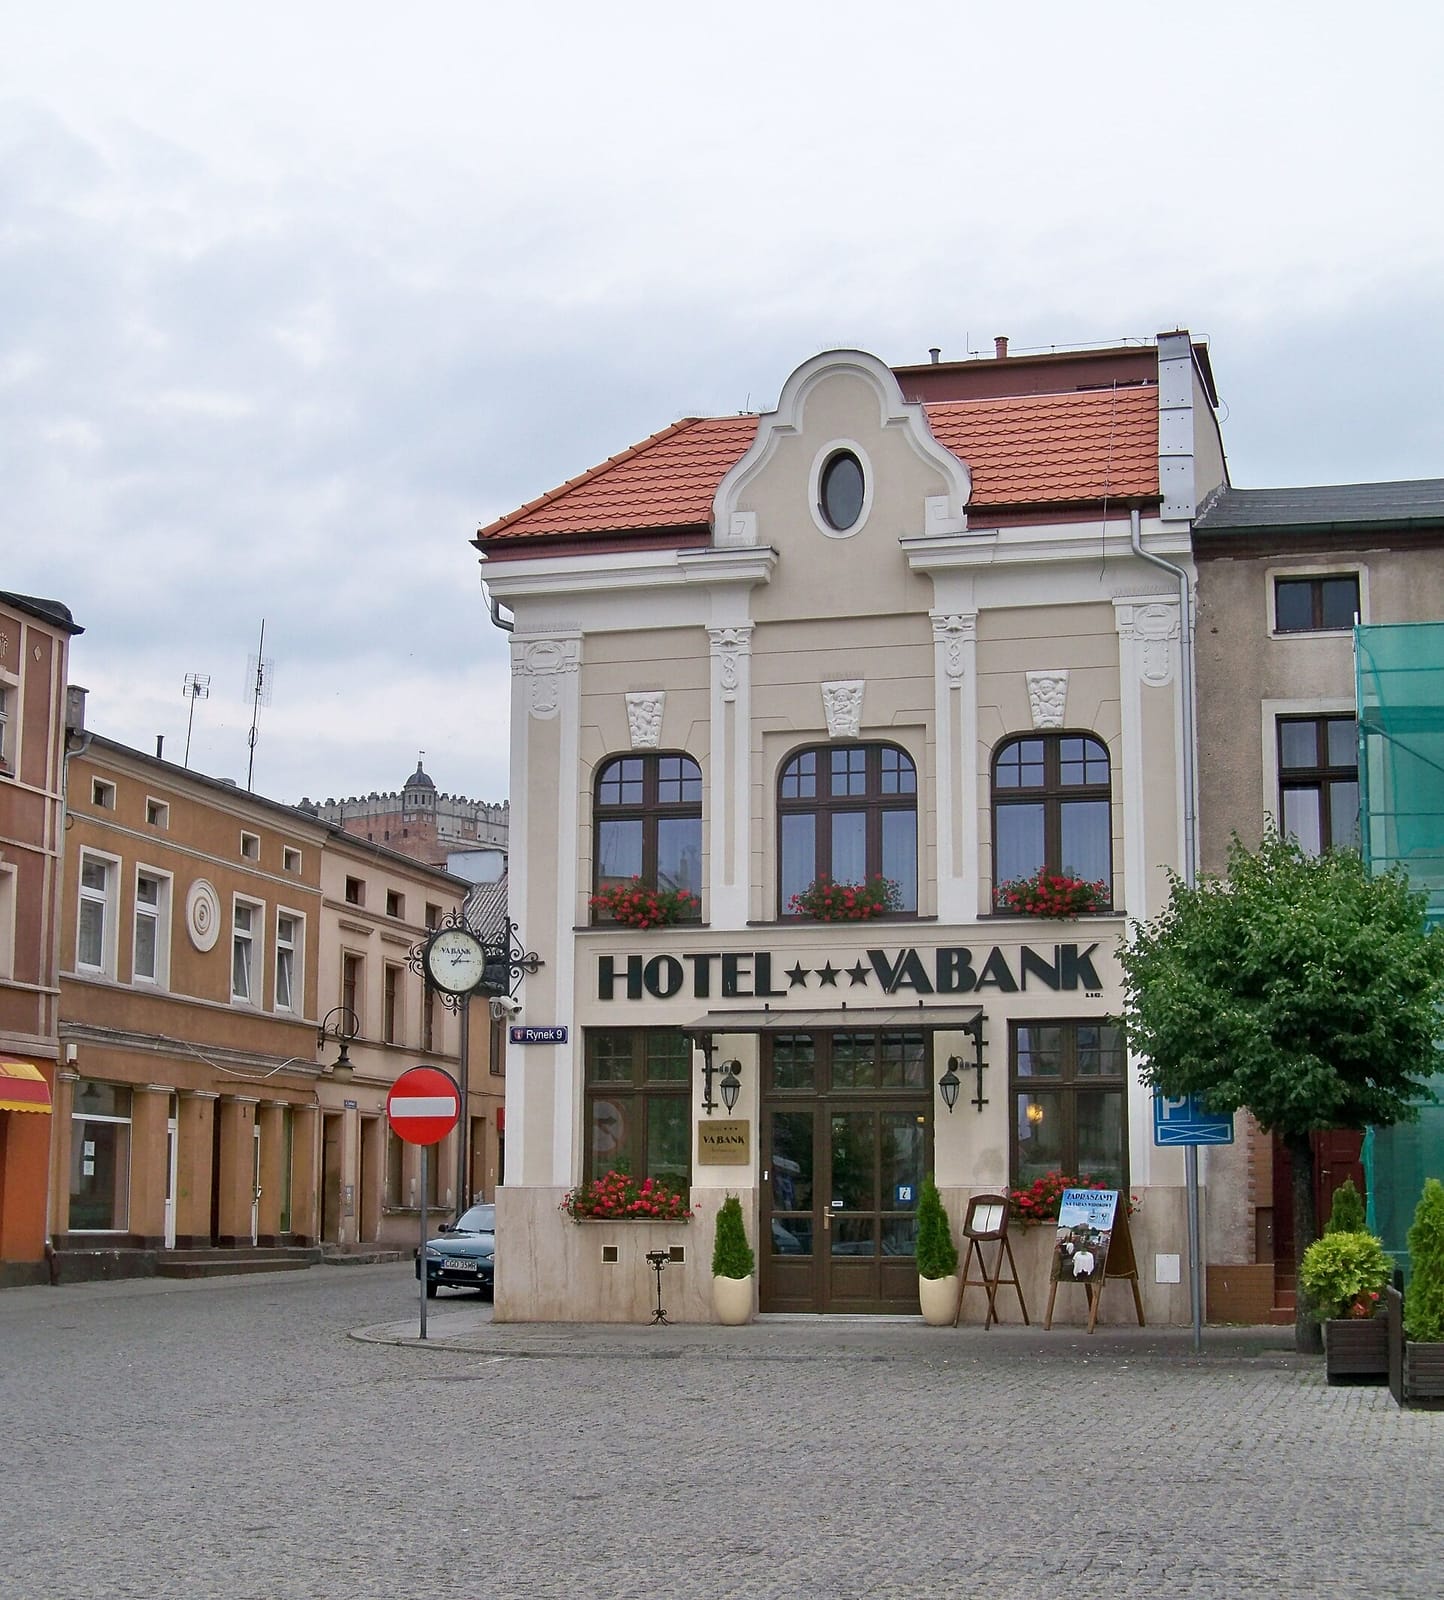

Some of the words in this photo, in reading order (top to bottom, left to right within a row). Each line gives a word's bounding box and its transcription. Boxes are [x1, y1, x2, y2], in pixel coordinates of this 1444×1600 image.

[598, 952, 788, 999] HOTEL
[526, 1029, 554, 1041] Rynek
[556, 1030, 563, 1039] 9
[1162, 1095, 1187, 1120] P
[1066, 1193, 1113, 1201] ZAPRASZAMY
